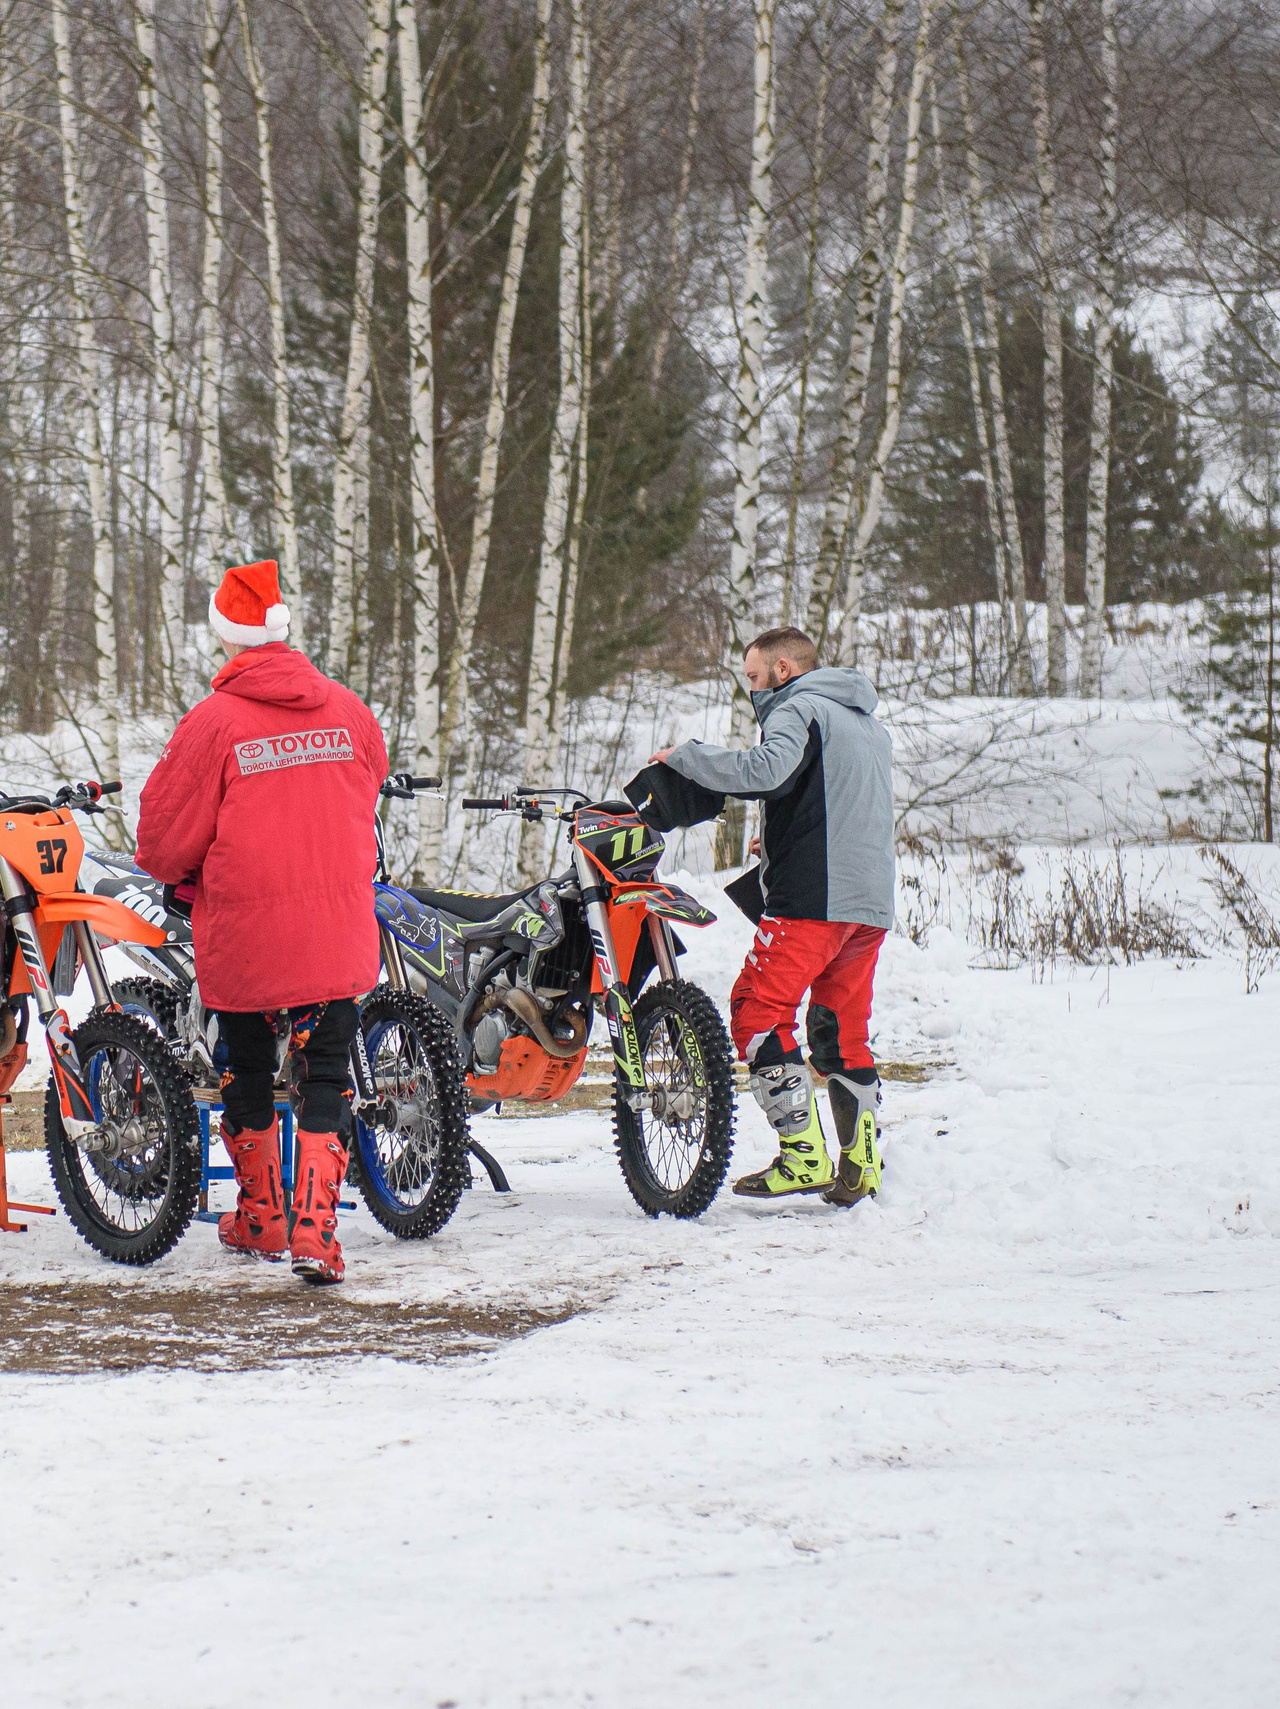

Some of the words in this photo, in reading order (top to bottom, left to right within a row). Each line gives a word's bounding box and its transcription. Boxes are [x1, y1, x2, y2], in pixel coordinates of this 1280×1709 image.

[268, 731, 351, 756] TOYOTA
[241, 762, 275, 773] ТОЙОТА
[276, 755, 303, 767] ЦЕНТР
[305, 751, 354, 761] ИЗМАЙЛОВО
[578, 824, 598, 834] Twin
[610, 825, 645, 861] 11
[36, 839, 67, 875] 37
[863, 1119, 873, 1164] GAERNE
